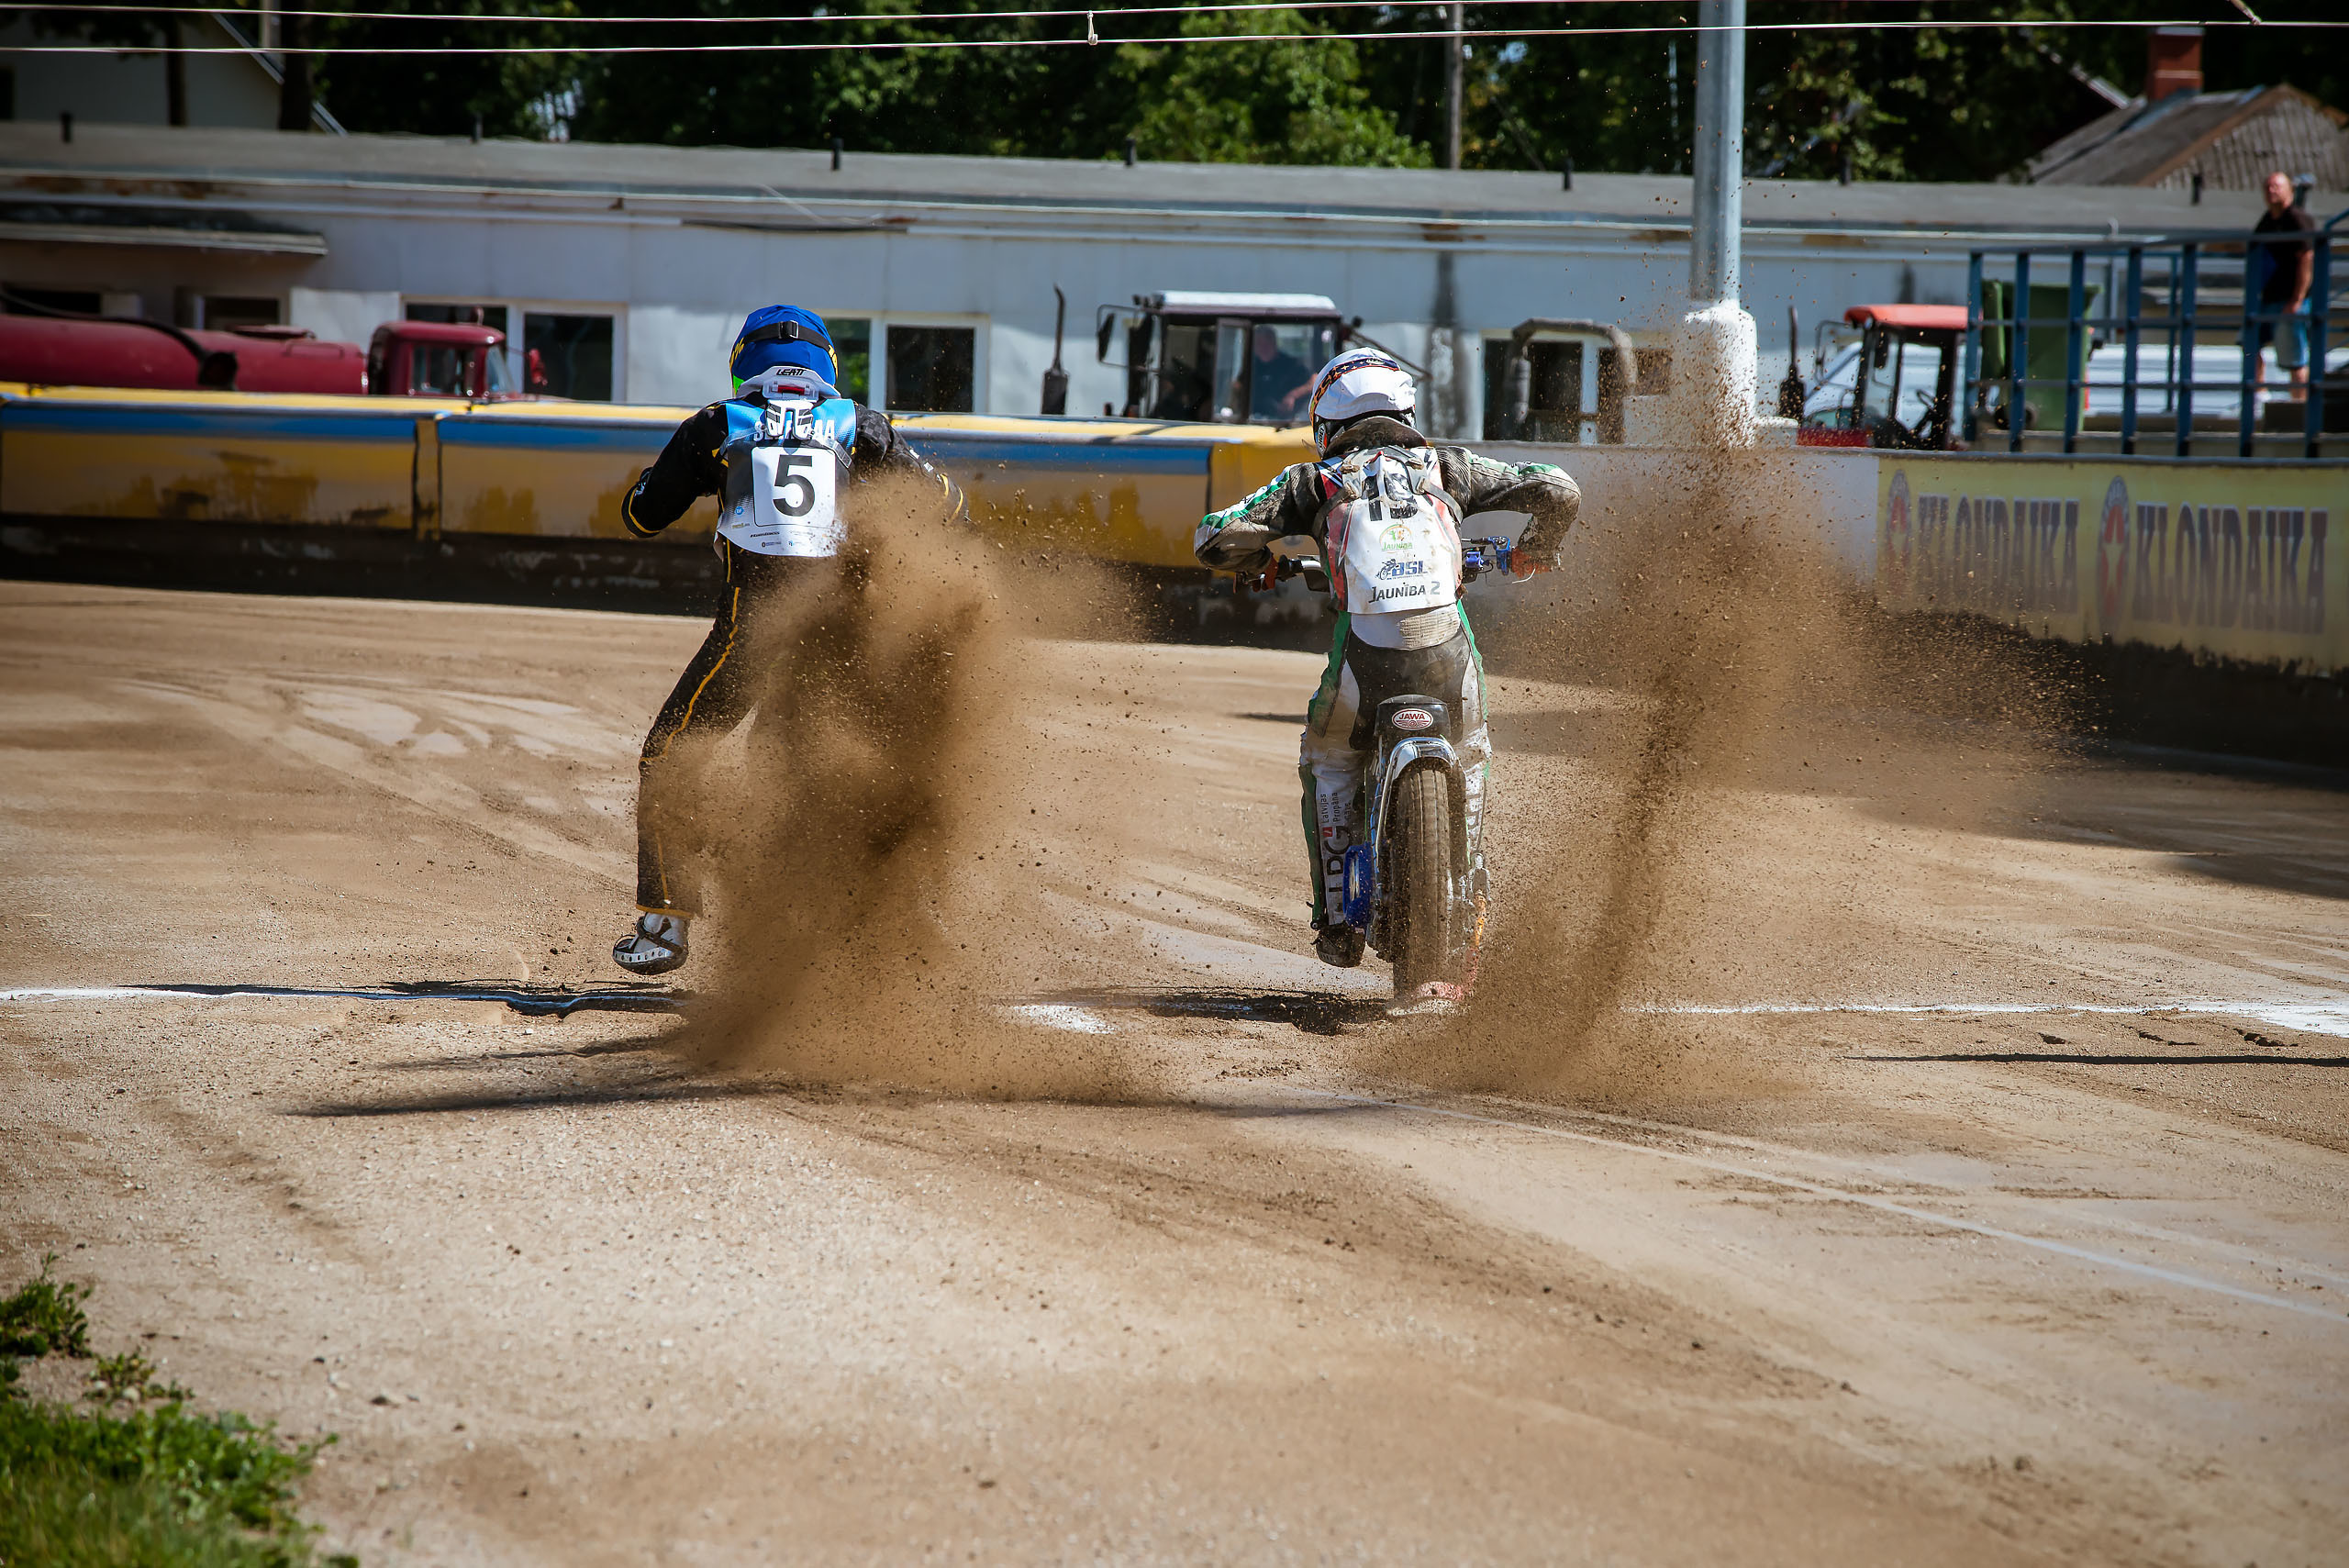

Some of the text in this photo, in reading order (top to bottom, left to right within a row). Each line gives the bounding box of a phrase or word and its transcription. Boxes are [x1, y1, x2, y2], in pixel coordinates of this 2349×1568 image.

[773, 455, 815, 517] 5
[2132, 500, 2329, 635] KLONDAIKA
[1368, 582, 1441, 604] JAUNĪBA 2
[1320, 794, 1330, 824] Latvijas
[1331, 792, 1341, 823] Propāna
